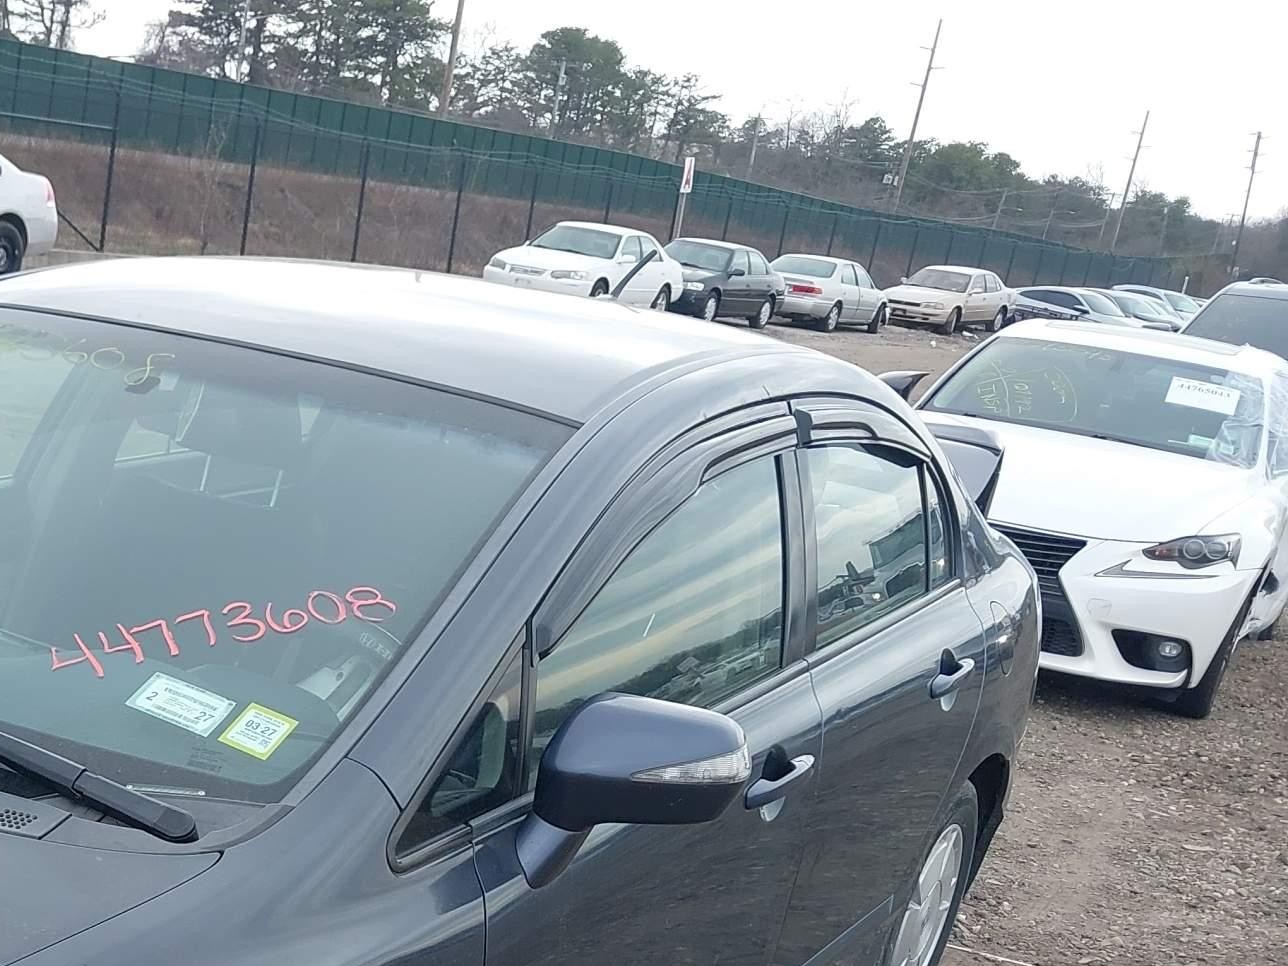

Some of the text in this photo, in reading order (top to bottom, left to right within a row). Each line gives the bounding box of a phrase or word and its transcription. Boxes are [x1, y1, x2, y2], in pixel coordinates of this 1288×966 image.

[49, 585, 397, 679] 44773608
[146, 691, 159, 702] 2
[195, 711, 216, 723] 27
